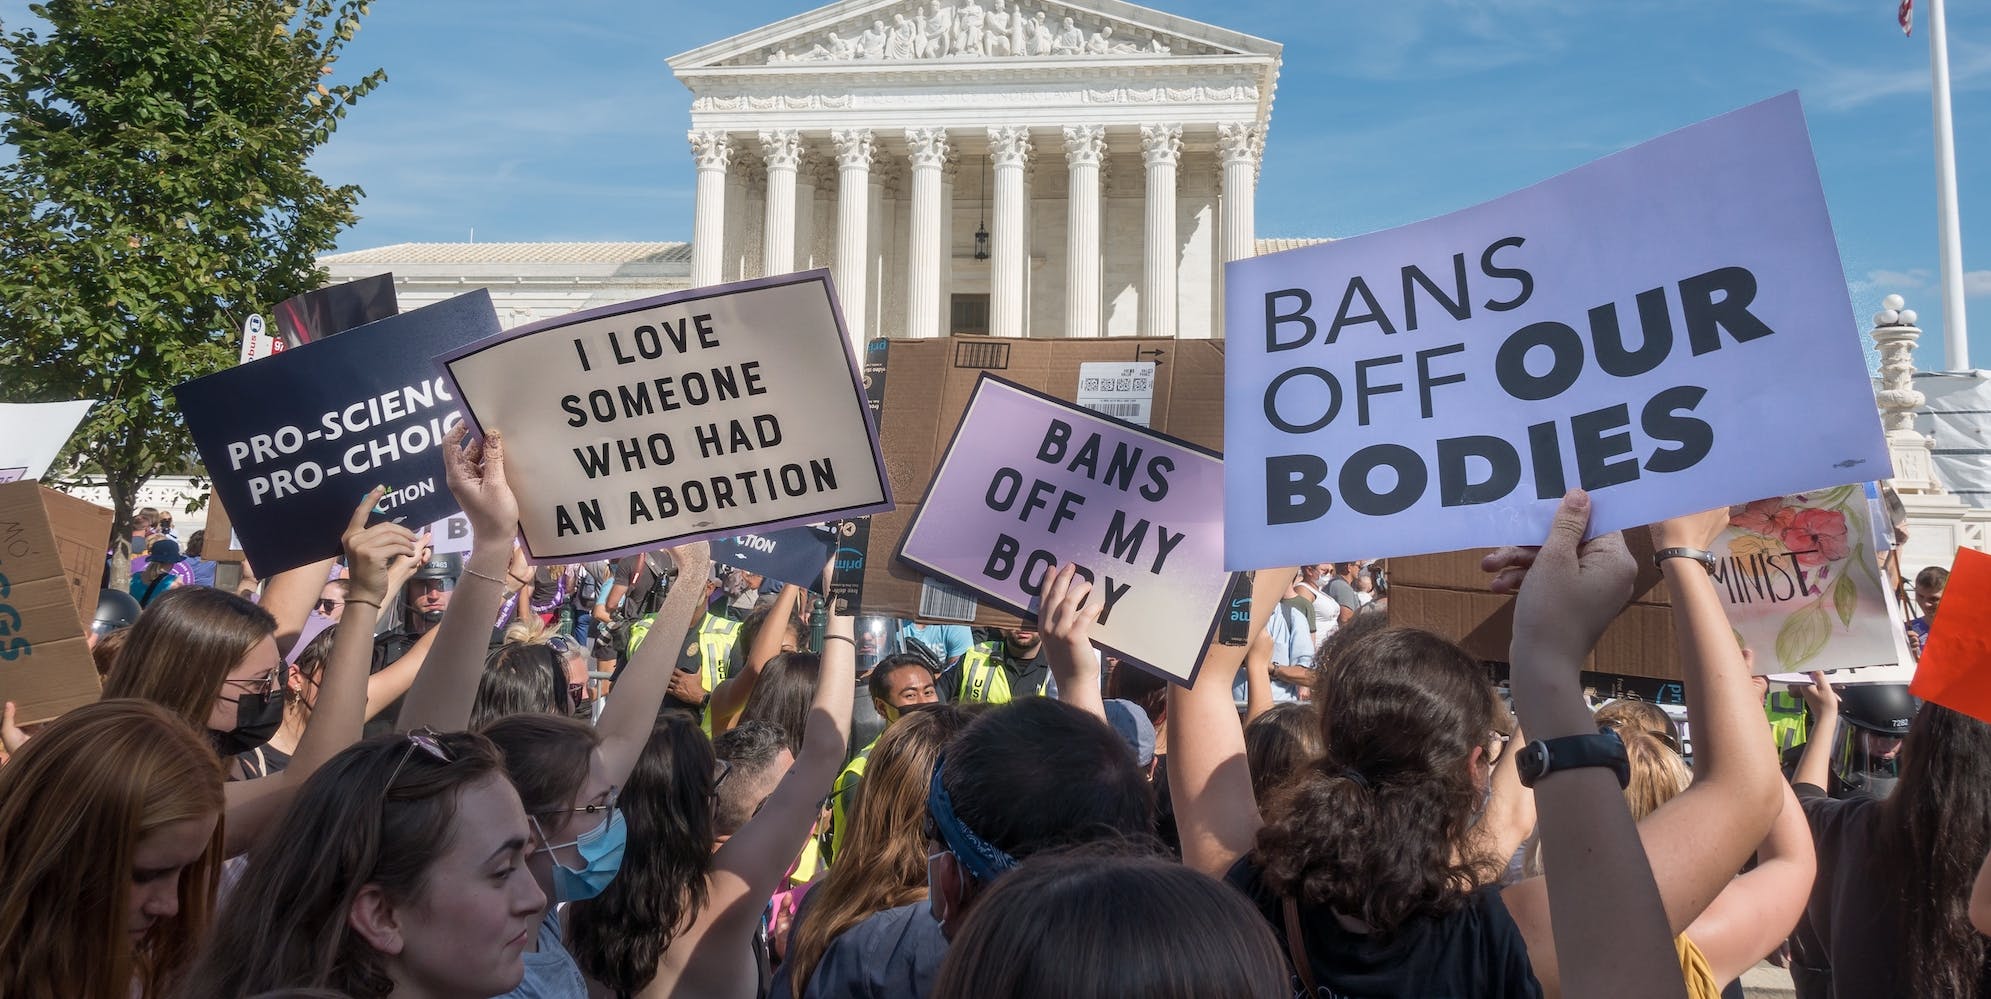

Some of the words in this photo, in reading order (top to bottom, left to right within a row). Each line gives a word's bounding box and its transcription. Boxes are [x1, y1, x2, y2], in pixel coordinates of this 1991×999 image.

[1264, 236, 1534, 354] BANS
[573, 338, 591, 372] I
[608, 313, 720, 365] LOVE
[1263, 342, 1466, 435] OFF
[1495, 266, 1776, 401] OUR
[560, 360, 767, 428] SOMEONE
[572, 432, 675, 479] WHO
[695, 413, 782, 459] HAD
[1035, 417, 1176, 503] BANS
[1265, 385, 1714, 526] BODIES
[556, 498, 606, 538] AN
[630, 457, 838, 526] ABORTION
[985, 467, 1087, 535] OFF
[1099, 509, 1186, 575] MY
[971, 679, 983, 698] US
